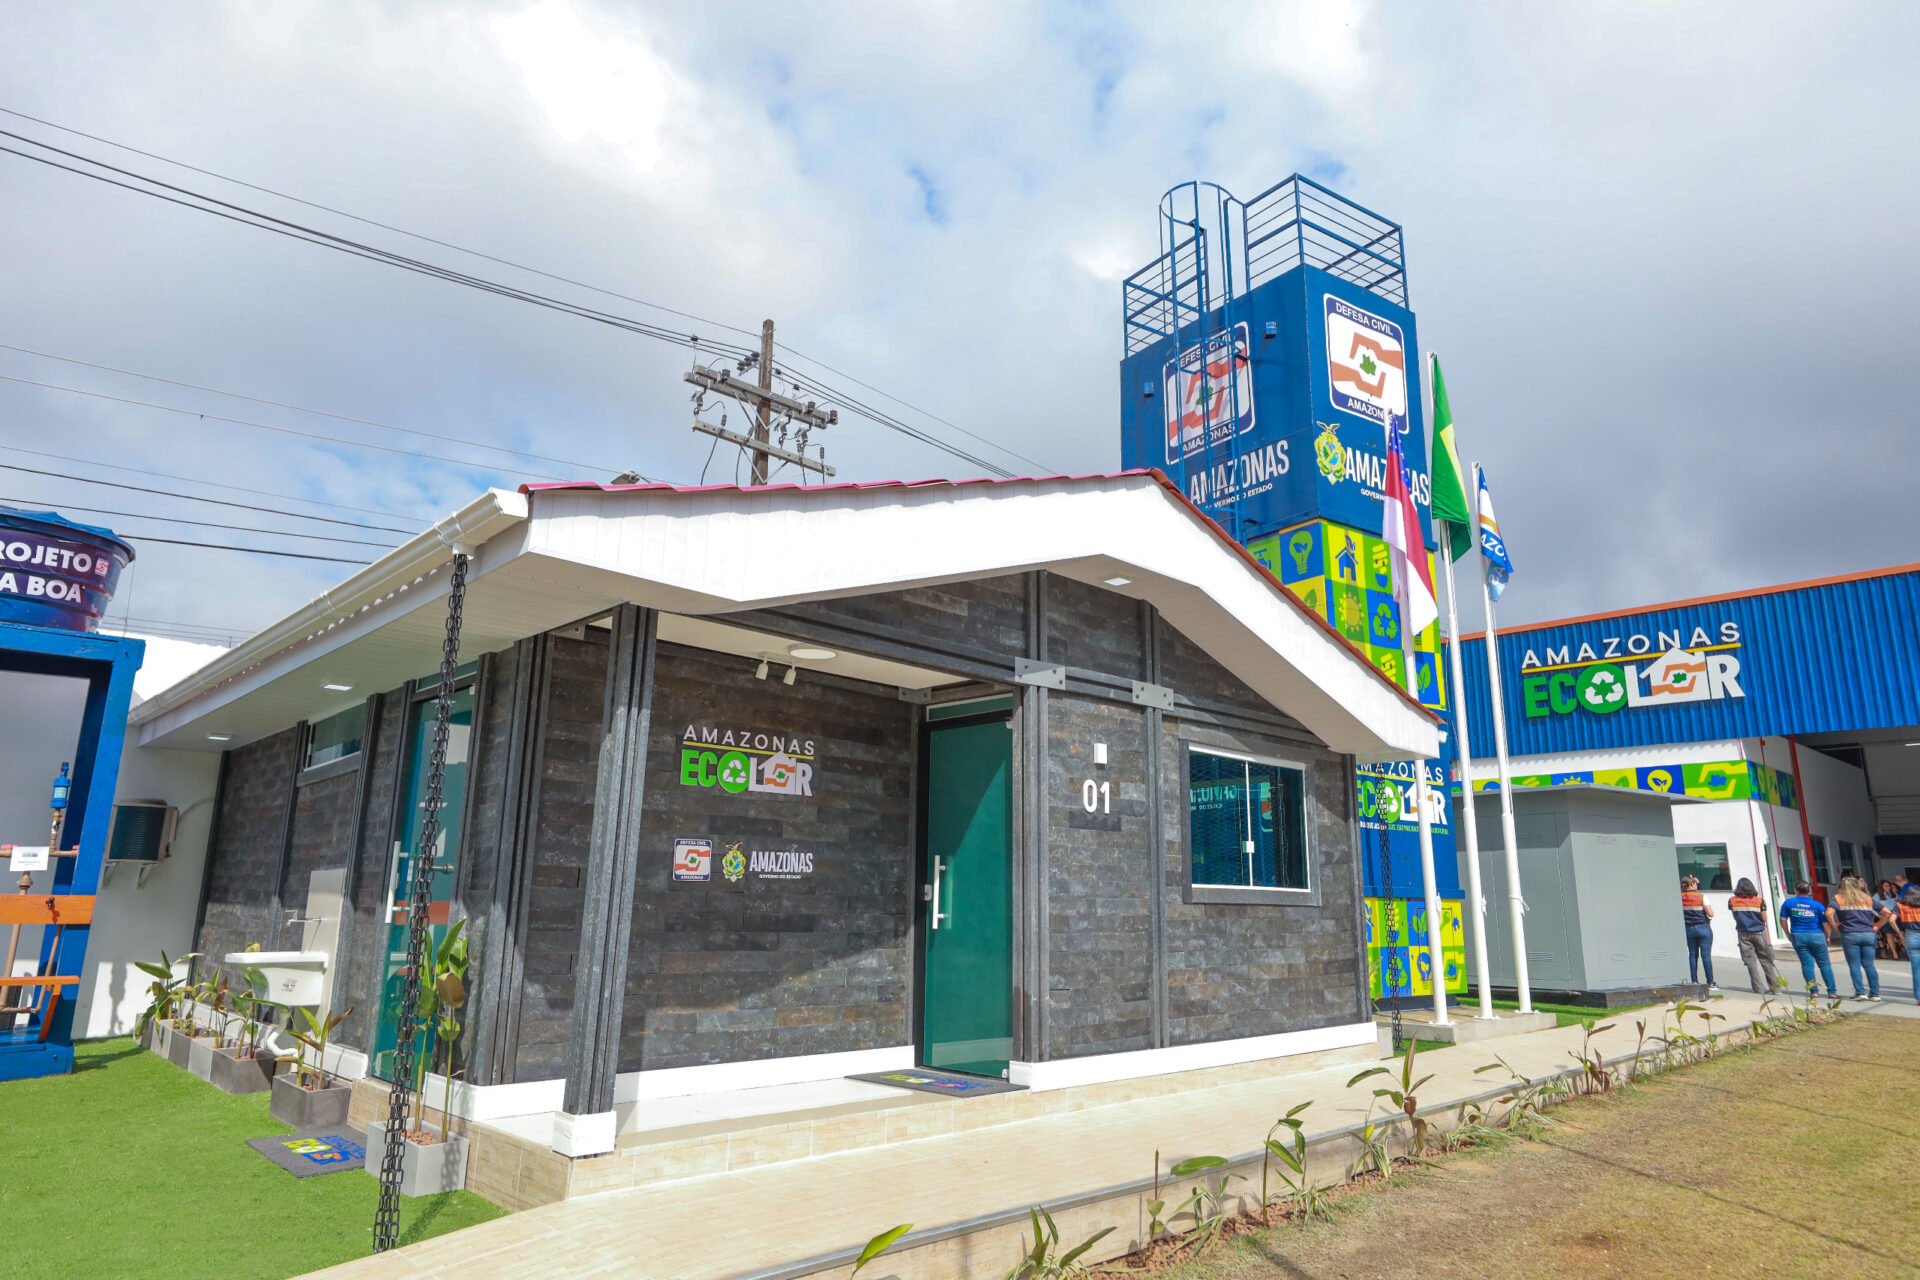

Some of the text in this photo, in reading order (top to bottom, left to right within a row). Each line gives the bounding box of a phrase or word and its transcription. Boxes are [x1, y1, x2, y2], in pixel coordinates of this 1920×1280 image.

[1335, 301, 1394, 336] DEFESA CIVIL
[1179, 332, 1231, 368] EFES CIVI
[1347, 398, 1392, 422] AMAZON
[1247, 483, 1273, 498] ESTADO
[1345, 446, 1430, 506] AMAZAS
[1360, 488, 1385, 501] GOVERN
[26, 575, 82, 604] BOA
[1521, 622, 1741, 669] AMAZONAS
[683, 724, 815, 756] AMAZONAS
[1356, 761, 1444, 783] MAZOAS
[1082, 778, 1110, 815] 01
[749, 850, 814, 873] AMAZONAS
